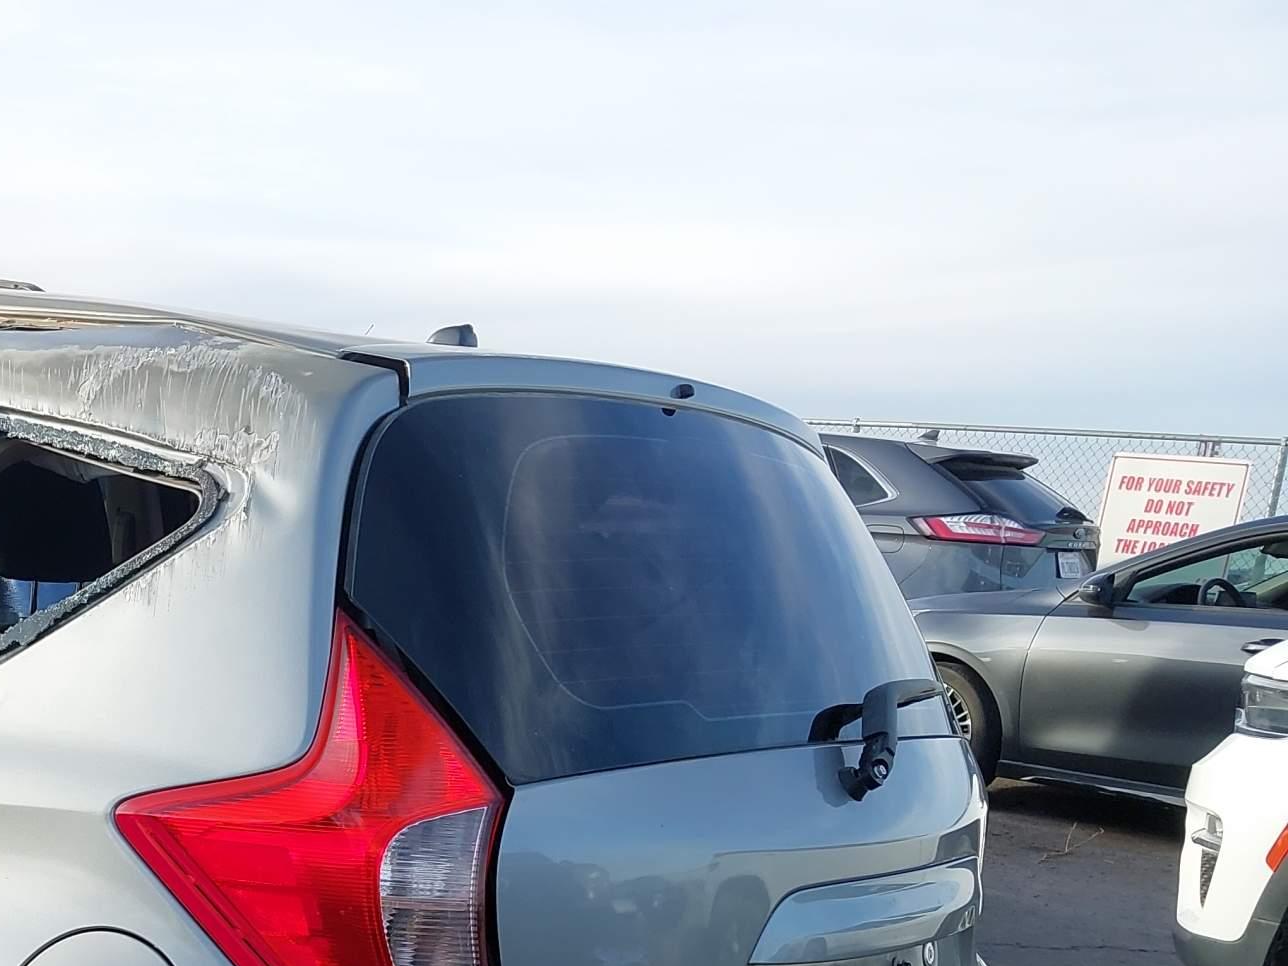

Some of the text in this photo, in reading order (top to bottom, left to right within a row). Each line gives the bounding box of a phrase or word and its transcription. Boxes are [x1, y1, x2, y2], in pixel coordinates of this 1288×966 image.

[1118, 475, 1236, 499] FOR YOUR SAFETY
[1144, 498, 1195, 517] DO NOT
[1126, 518, 1200, 538] APPROACH
[1114, 538, 1139, 555] THE
